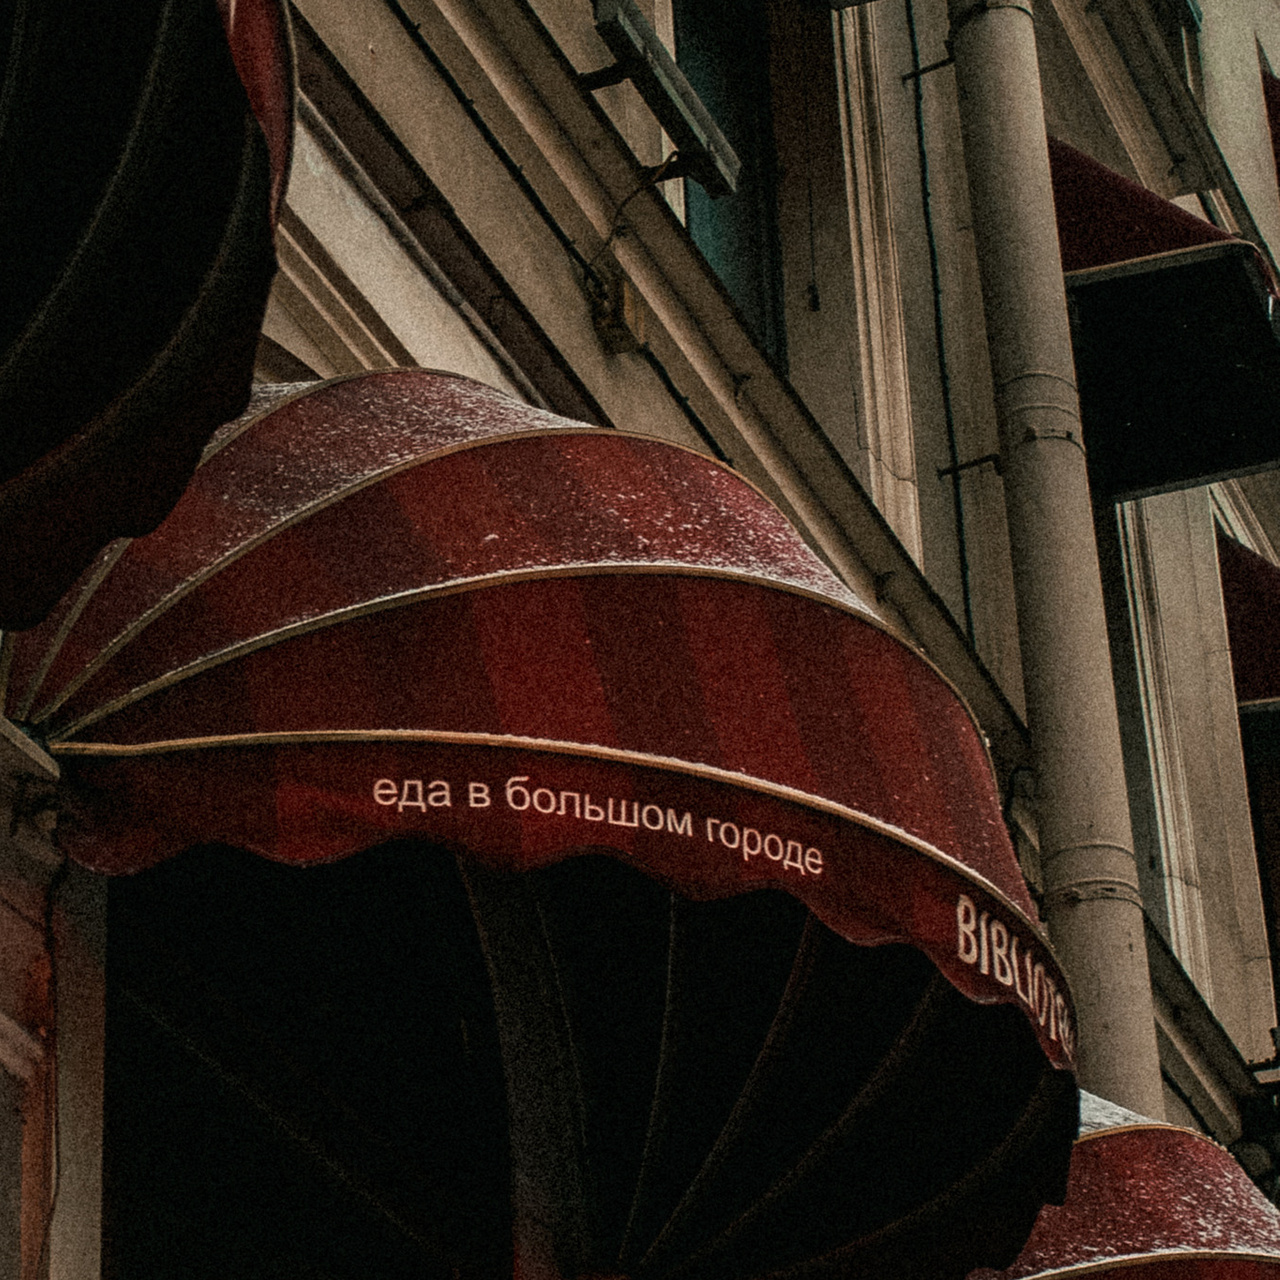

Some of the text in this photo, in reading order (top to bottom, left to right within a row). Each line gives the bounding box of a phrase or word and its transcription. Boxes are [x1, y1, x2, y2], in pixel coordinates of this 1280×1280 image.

[373, 775, 824, 875] еда в большом городе
